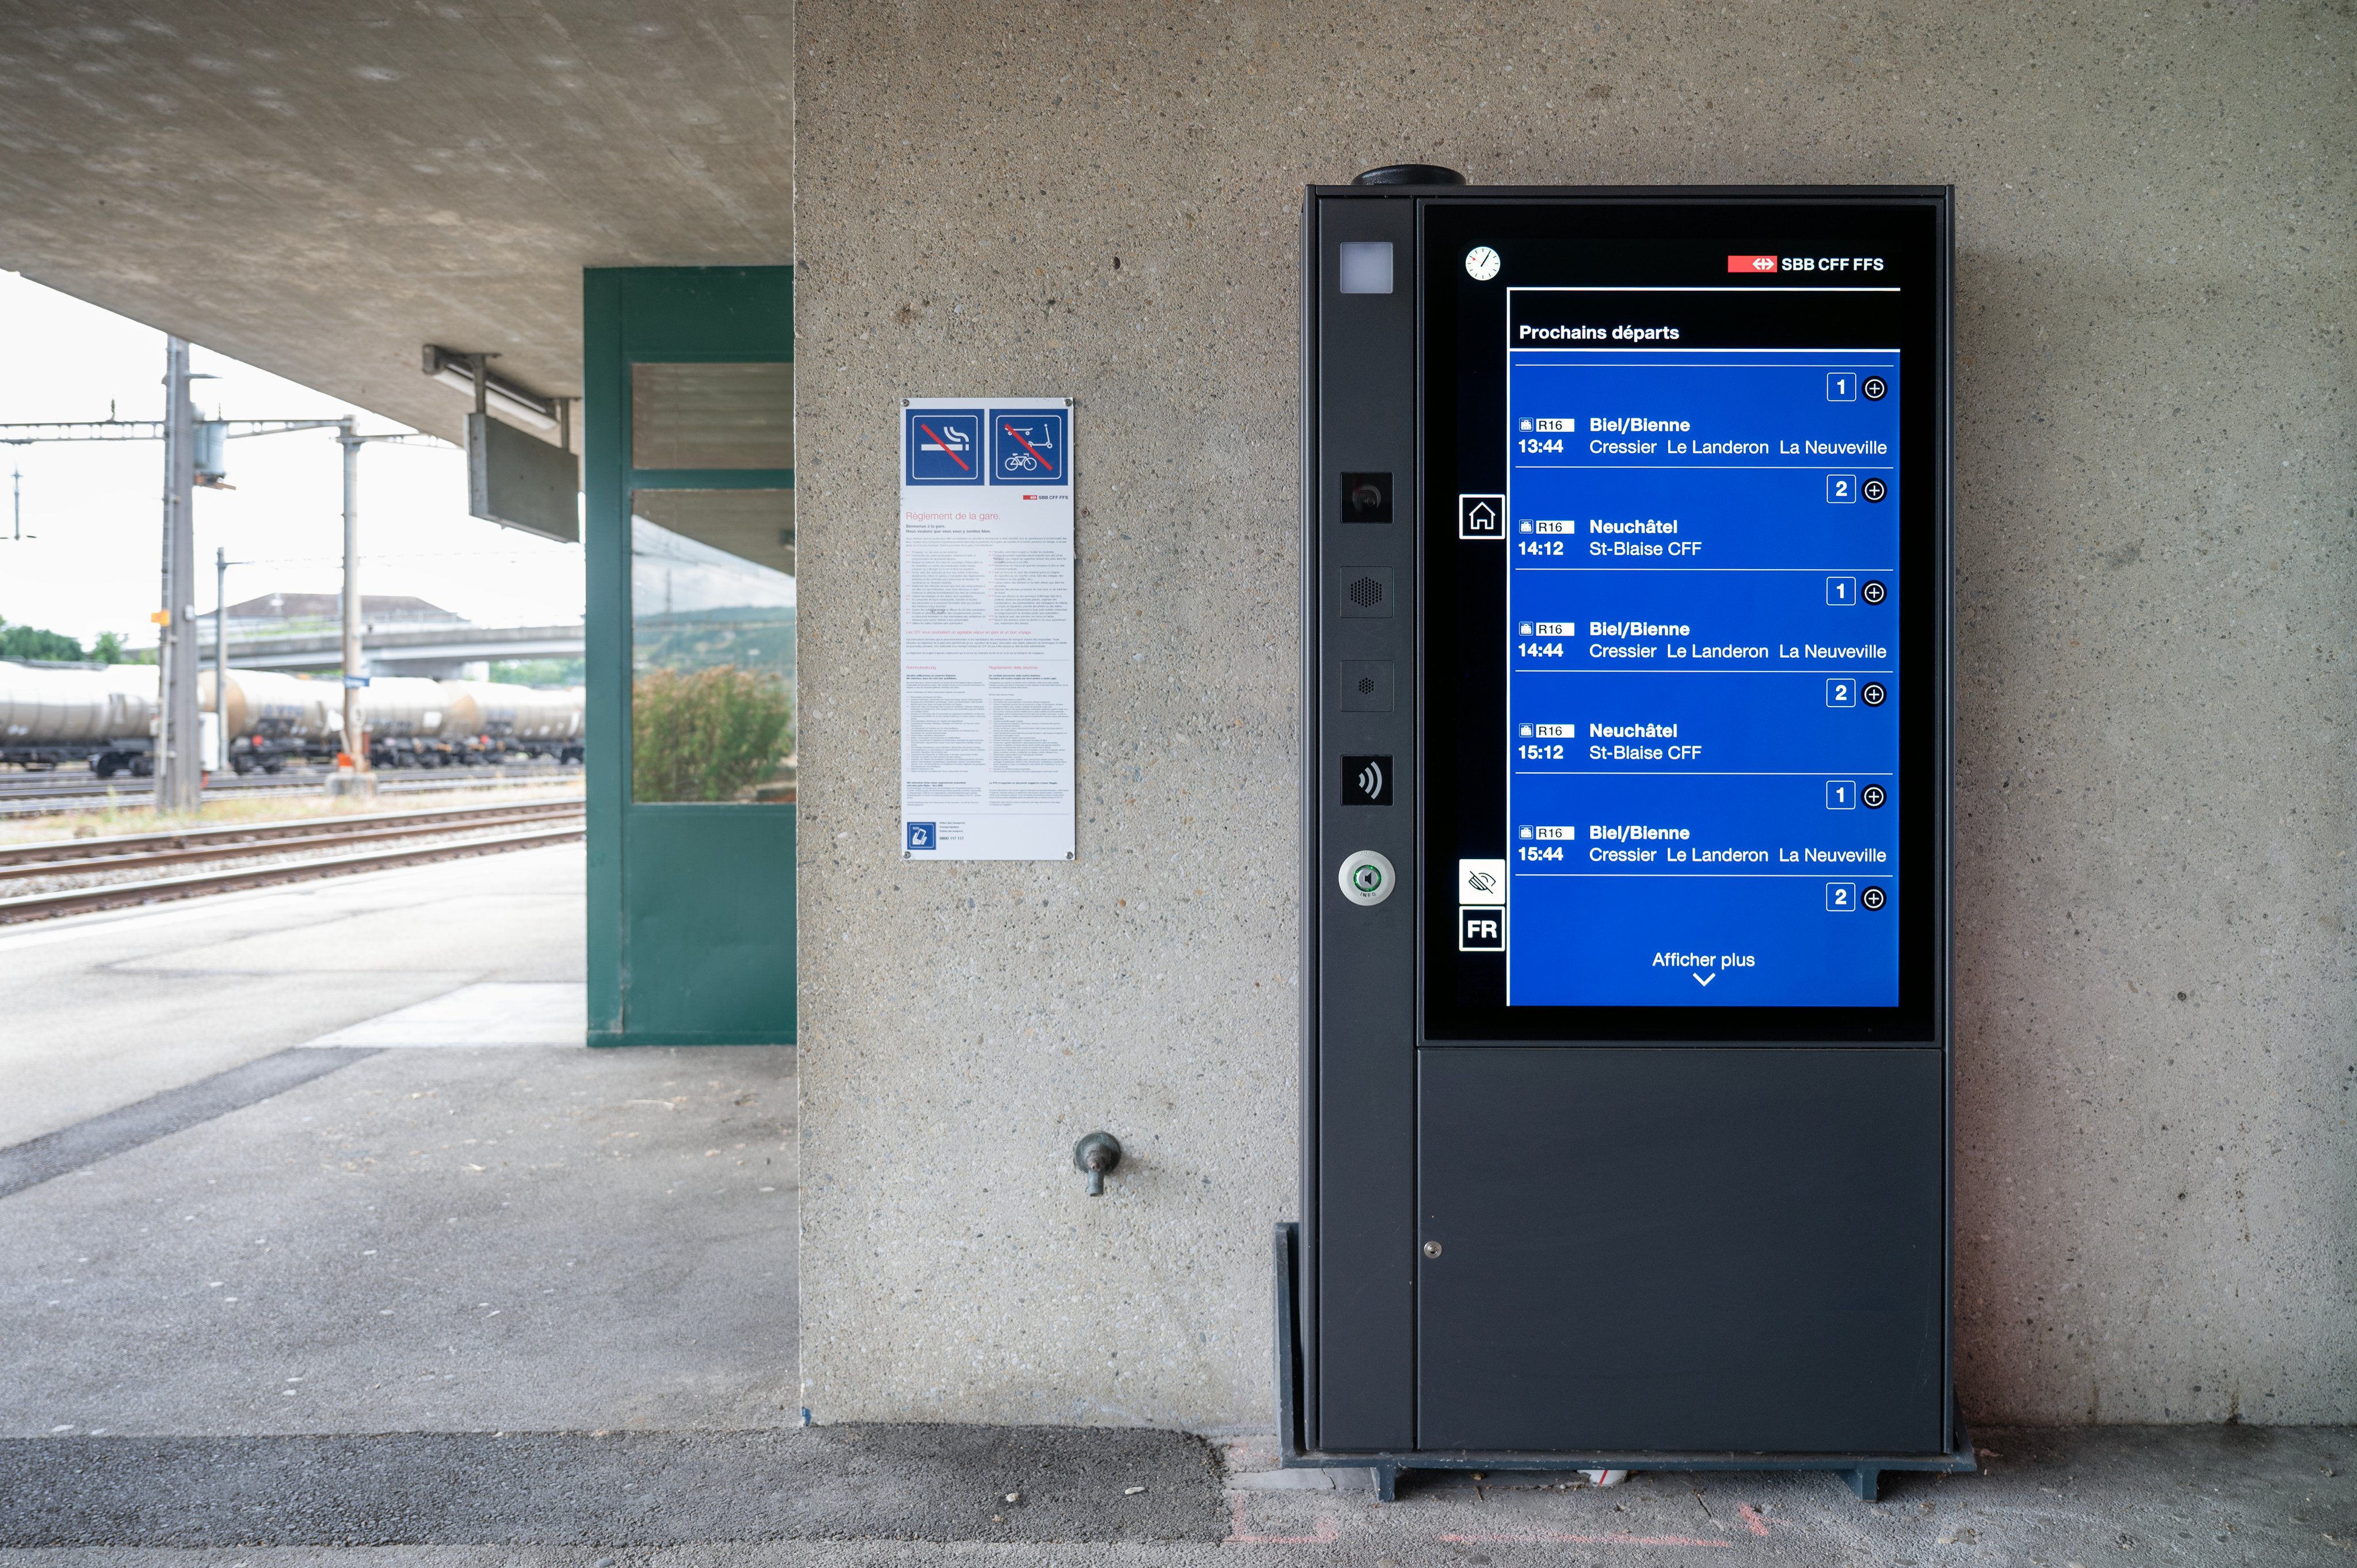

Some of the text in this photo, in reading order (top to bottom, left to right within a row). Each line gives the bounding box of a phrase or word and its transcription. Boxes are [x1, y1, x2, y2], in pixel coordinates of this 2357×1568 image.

[1782, 258, 1884, 271] SBB CFF FFS
[1520, 325, 1680, 343] Prochains départs
[1837, 379, 1845, 395] 1
[1539, 421, 1562, 430] R16
[1590, 417, 1690, 435] Biel/Bienne
[1518, 439, 1564, 453] 13:44
[1589, 440, 1887, 455] Cressier Le Landeron La Neuveville
[1835, 481, 1848, 497] 2
[906, 512, 1001, 522] Règlement de la gare.
[1539, 522, 1562, 532] R16
[1590, 519, 1677, 534] Neuchâtel
[1518, 541, 1563, 555] 14:12
[1589, 541, 1702, 556] St-Blaise CFF
[1836, 583, 1844, 599] 1
[1539, 624, 1562, 634] R16
[1590, 621, 1690, 639] Biel/Bienne
[1518, 643, 1564, 657] 14:44
[1589, 643, 1887, 658] Cressier Le Landeron La Neuveville
[1835, 685, 1847, 701] 2
[1539, 726, 1562, 736] R16
[1590, 723, 1677, 738] Neuchâtel
[1518, 745, 1563, 759] 15:12
[1589, 745, 1702, 760] St-Blaise CFF
[1836, 787, 1844, 803] 1
[1539, 828, 1562, 838] R16
[1590, 825, 1690, 843] Biel/Bienne
[1518, 847, 1564, 861] 15:44
[1589, 847, 1887, 863] Cressier Le Landeron La Neuveville
[1835, 889, 1847, 905] 2
[1467, 920, 1497, 938] FR
[1652, 952, 1755, 970] Afficher plus
